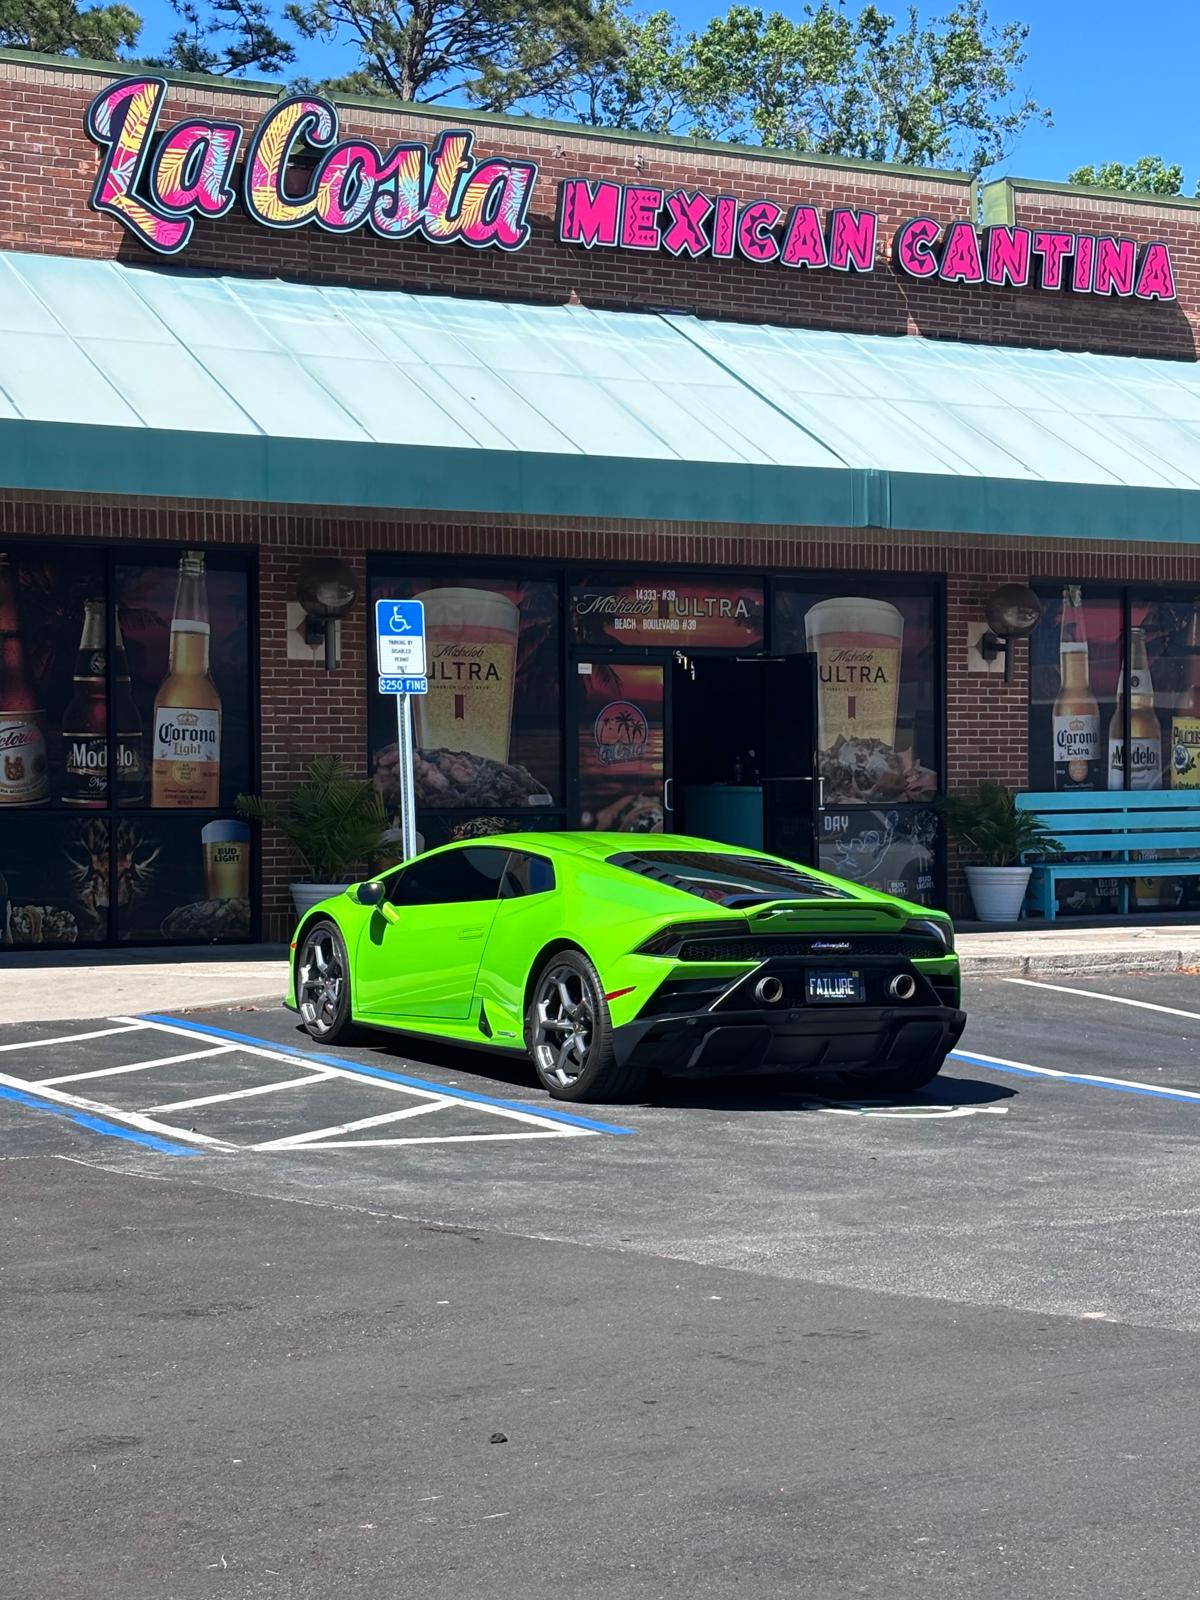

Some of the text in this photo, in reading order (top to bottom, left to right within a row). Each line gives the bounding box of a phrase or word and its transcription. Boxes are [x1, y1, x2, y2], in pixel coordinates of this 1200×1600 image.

[84, 75, 539, 255] La Costa
[558, 178, 1178, 301] MEXICAN CANTINA
[576, 594, 749, 618] Michelob ULTRA
[614, 618, 697, 631] BEACH BOULEVARD #39
[431, 644, 484, 658] Michelob
[819, 665, 887, 683] ULTRA
[380, 679, 403, 691] $250
[406, 680, 426, 690] FINE
[158, 722, 216, 747] Corona
[1056, 729, 1098, 750] Corona
[72, 743, 133, 768] Modlo
[173, 742, 201, 756] Light
[1066, 746, 1090, 756] Extra
[1115, 745, 1156, 765] Mdelo
[824, 815, 849, 833] DAY
[214, 854, 240, 863] LIGHT
[1095, 887, 1119, 897] LIGHT
[1098, 879, 1118, 888] BUD
[809, 977, 855, 995] FAILURE
